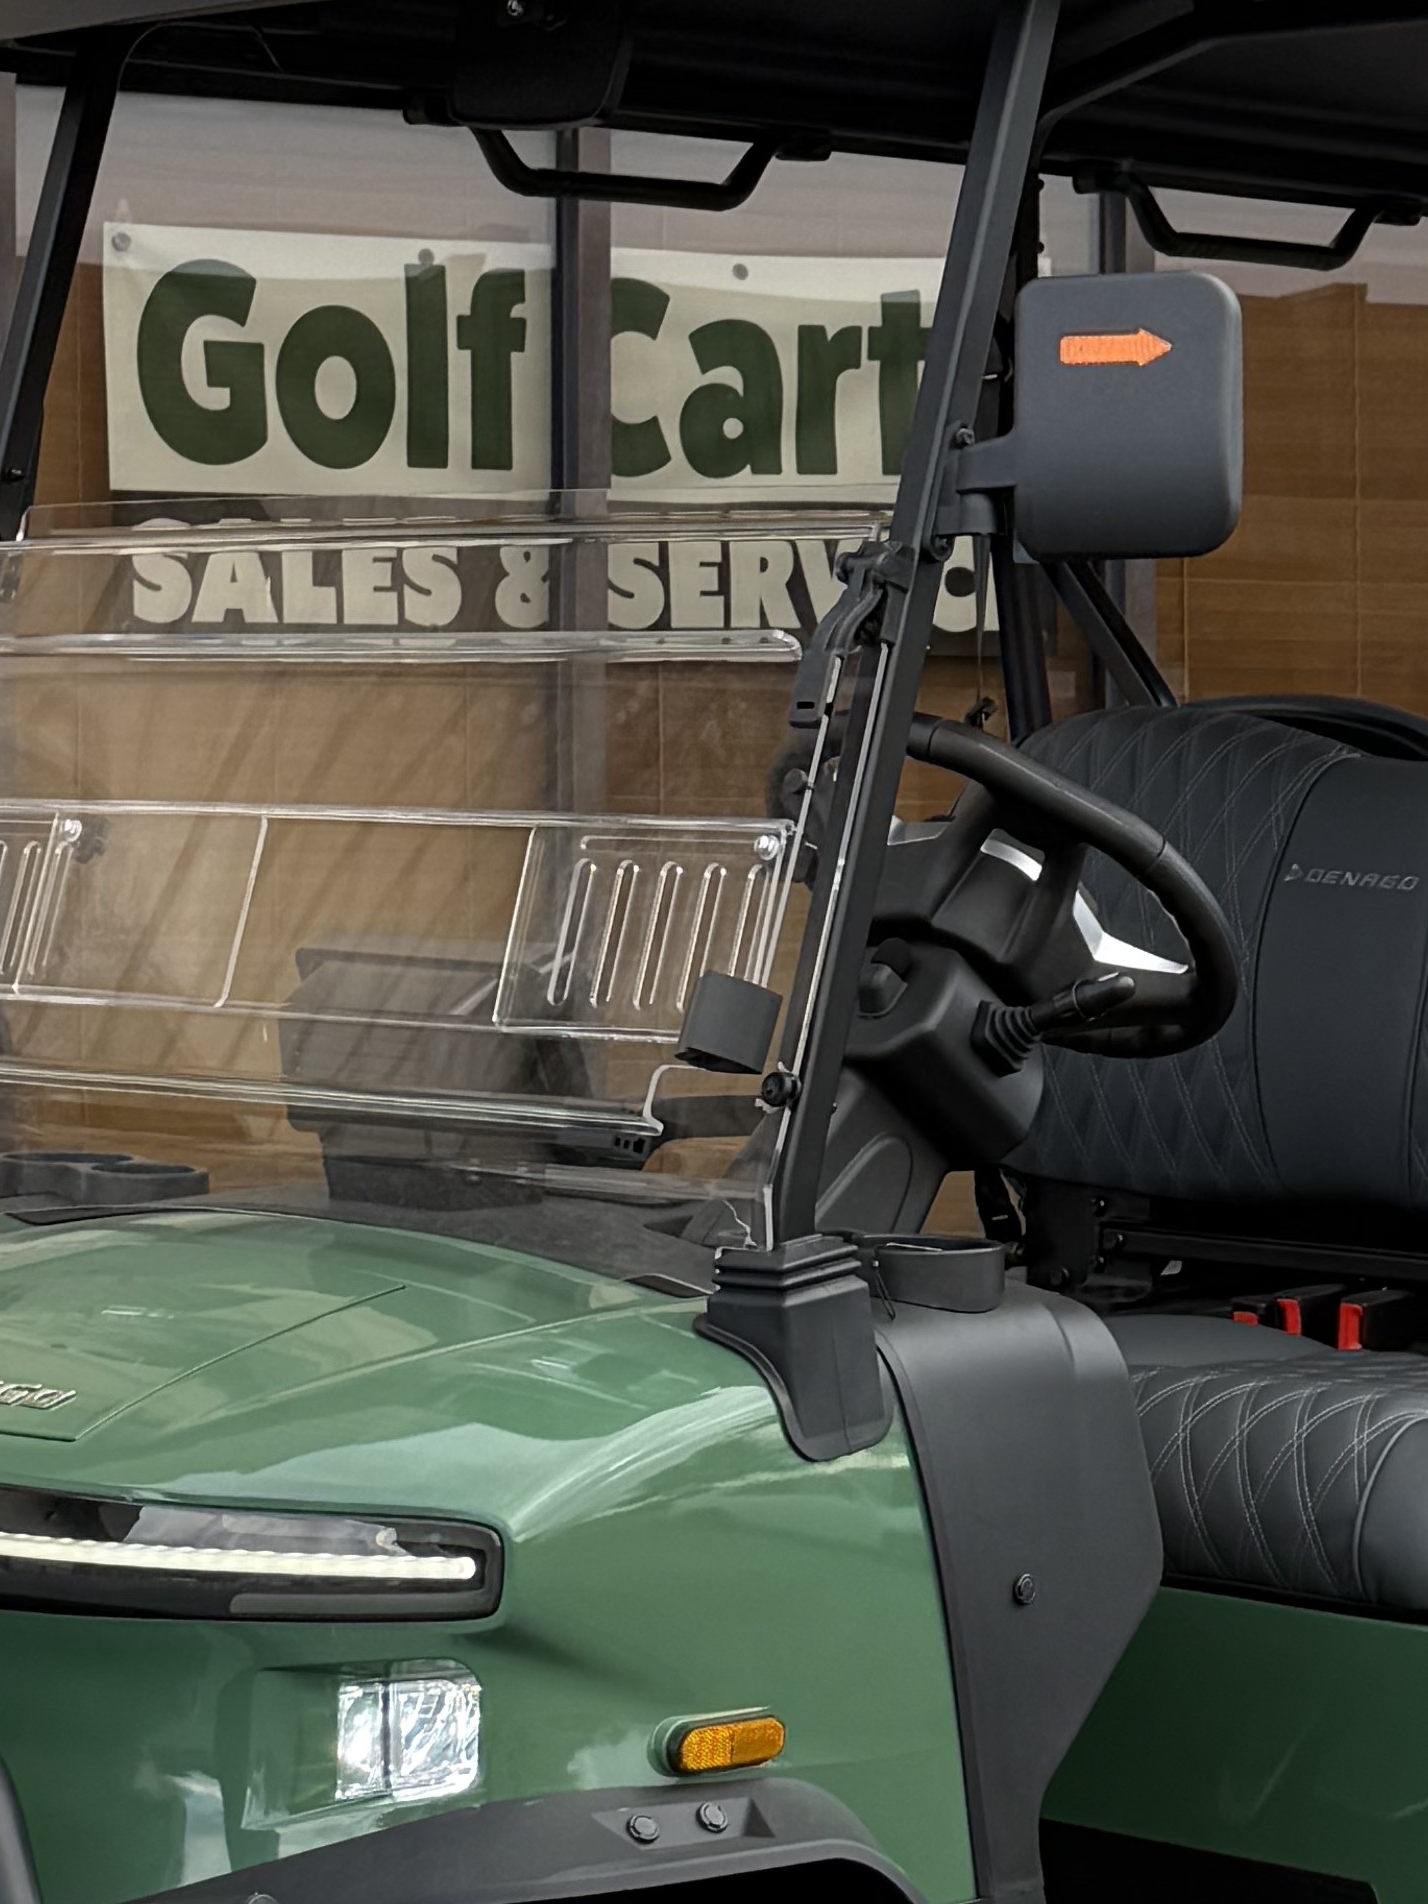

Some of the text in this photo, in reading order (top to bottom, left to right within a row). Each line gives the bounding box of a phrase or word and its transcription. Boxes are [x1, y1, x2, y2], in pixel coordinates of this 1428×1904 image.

[136, 258, 935, 479] Golf Cart
[131, 517, 463, 628] SALES
[494, 514, 550, 629] &
[1304, 867, 1420, 891] DENAGO
